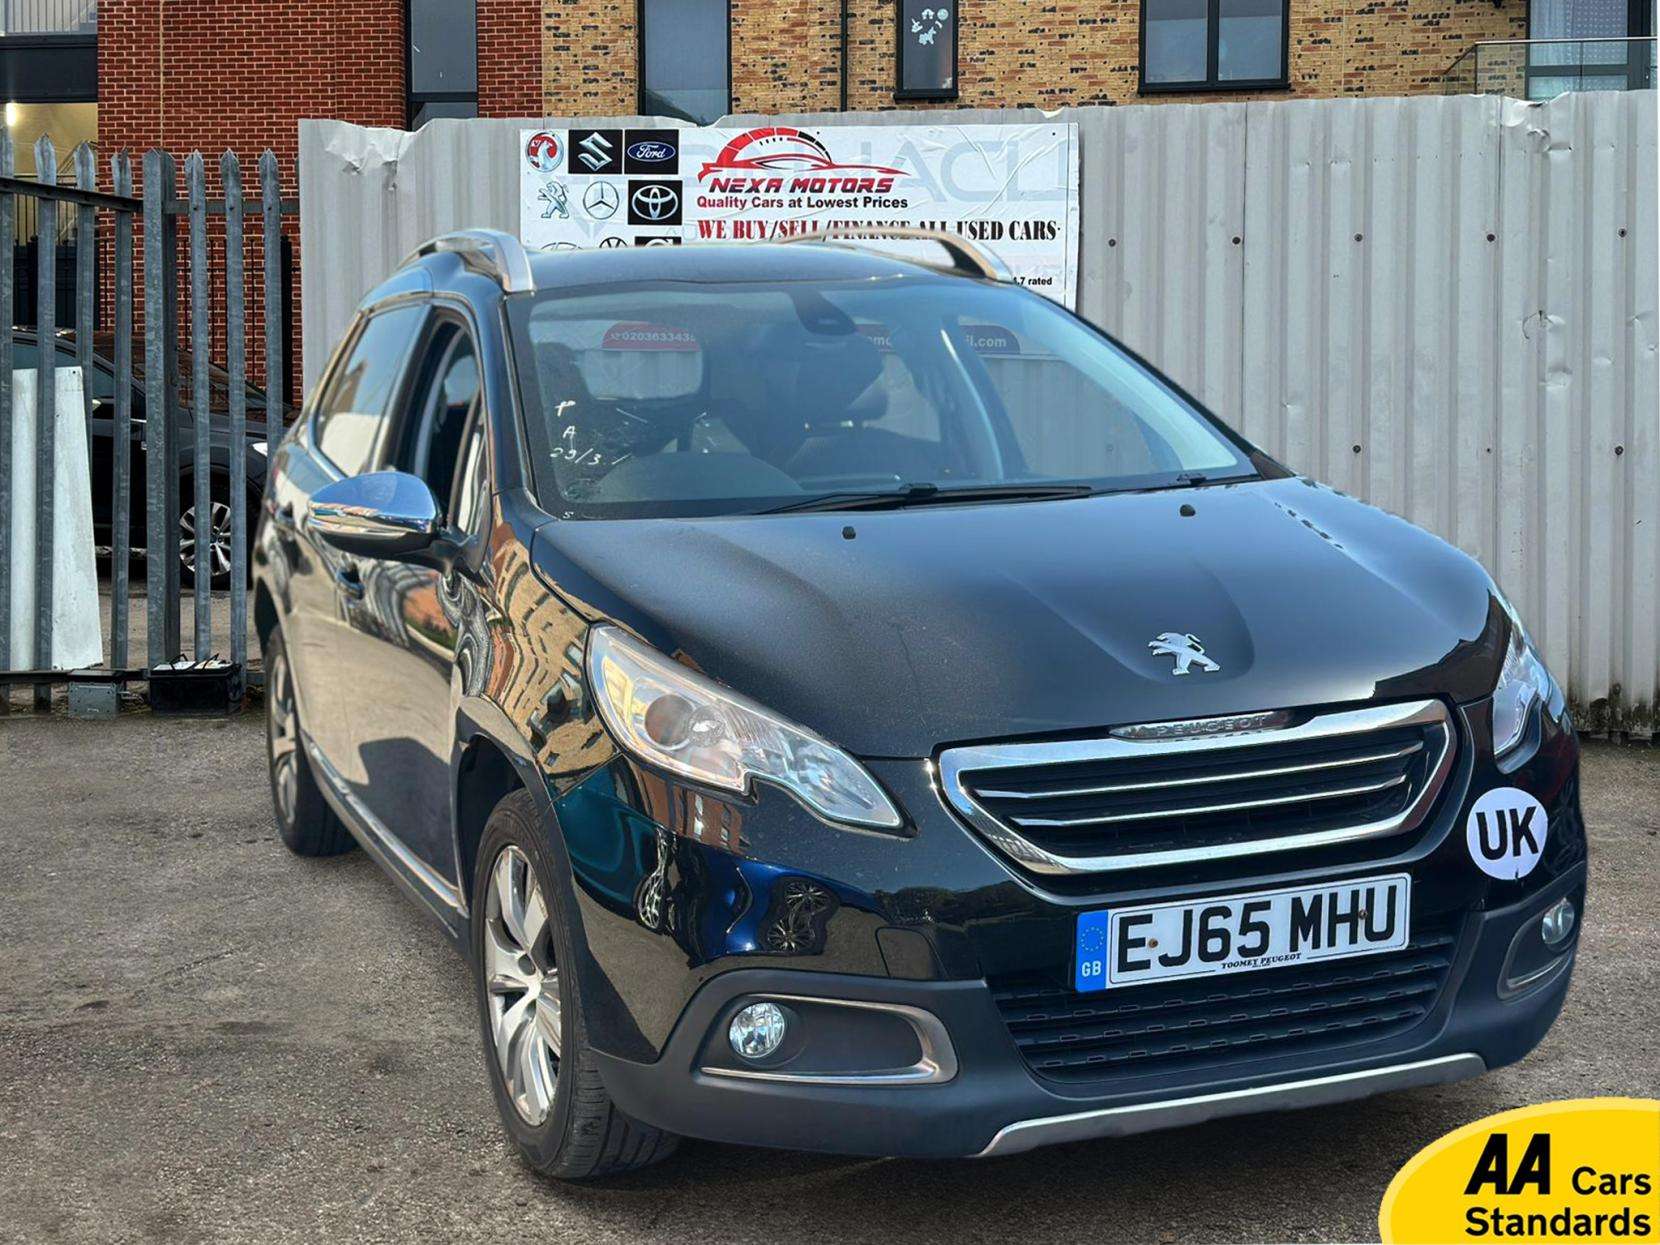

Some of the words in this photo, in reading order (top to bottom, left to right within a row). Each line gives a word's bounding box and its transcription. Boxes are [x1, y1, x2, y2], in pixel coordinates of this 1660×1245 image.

[636, 144, 666, 159] Ford
[709, 178, 784, 193] NEXA
[789, 177, 894, 193] MOTORS
[697, 196, 748, 210] Quality
[752, 196, 784, 208] Cars
[788, 197, 802, 208] at
[807, 196, 858, 208] Lowest
[863, 196, 908, 208] Prices
[697, 220, 726, 239] WE
[956, 220, 1003, 240] USED
[1028, 276, 1053, 286] rated
[1155, 715, 1267, 737] PEUGEOT
[1475, 805, 1540, 860] UK
[1117, 900, 1272, 974] EJ65
[1289, 885, 1399, 953] MHU
[1081, 959, 1103, 978] GB
[1221, 957, 1259, 969] TOOMEY
[1260, 952, 1302, 965] PEUGEOT
